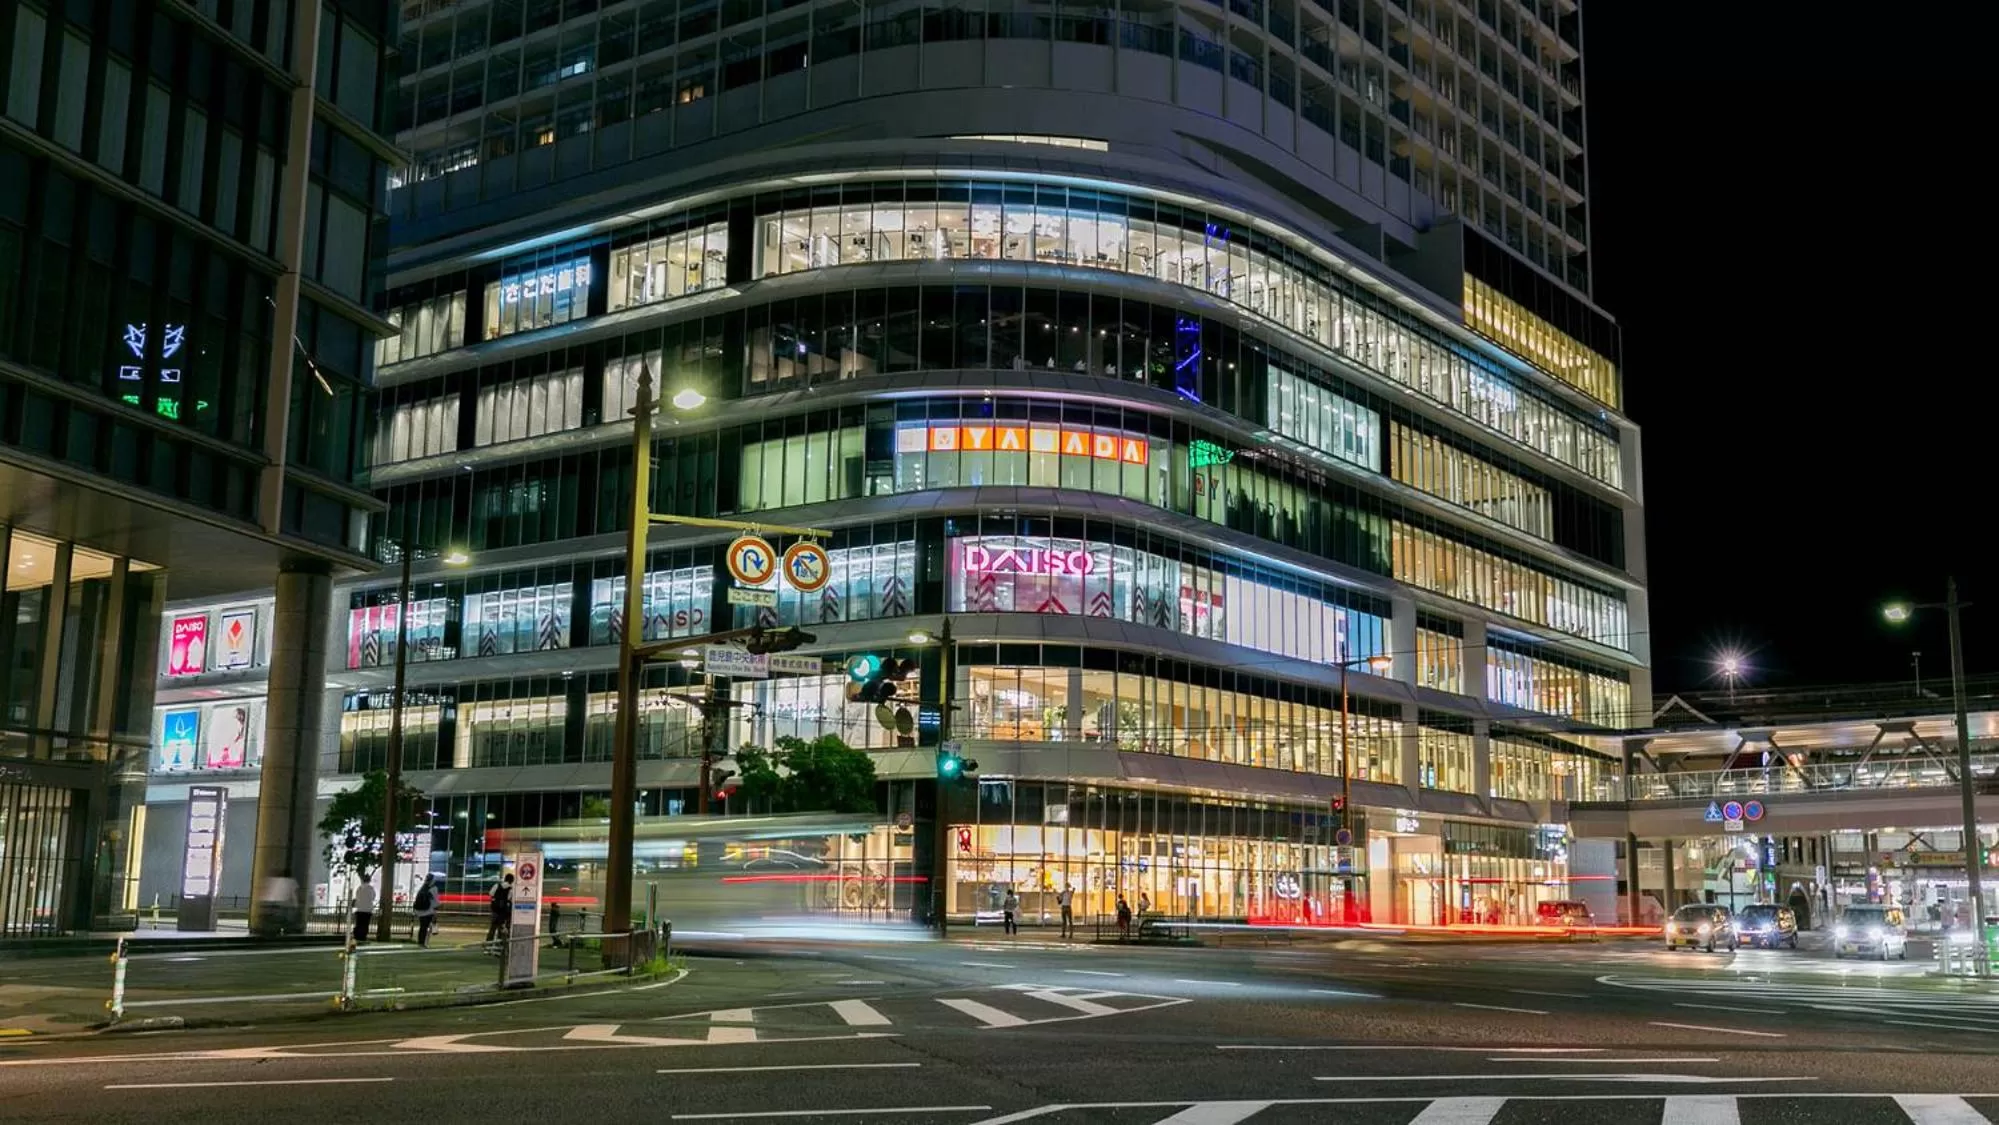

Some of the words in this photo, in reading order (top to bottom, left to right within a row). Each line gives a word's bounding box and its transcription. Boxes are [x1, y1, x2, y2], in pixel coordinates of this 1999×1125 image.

[506, 263, 591, 302] さこだ科
[966, 546, 1094, 575] DAISO
[175, 622, 203, 633] DAISO
